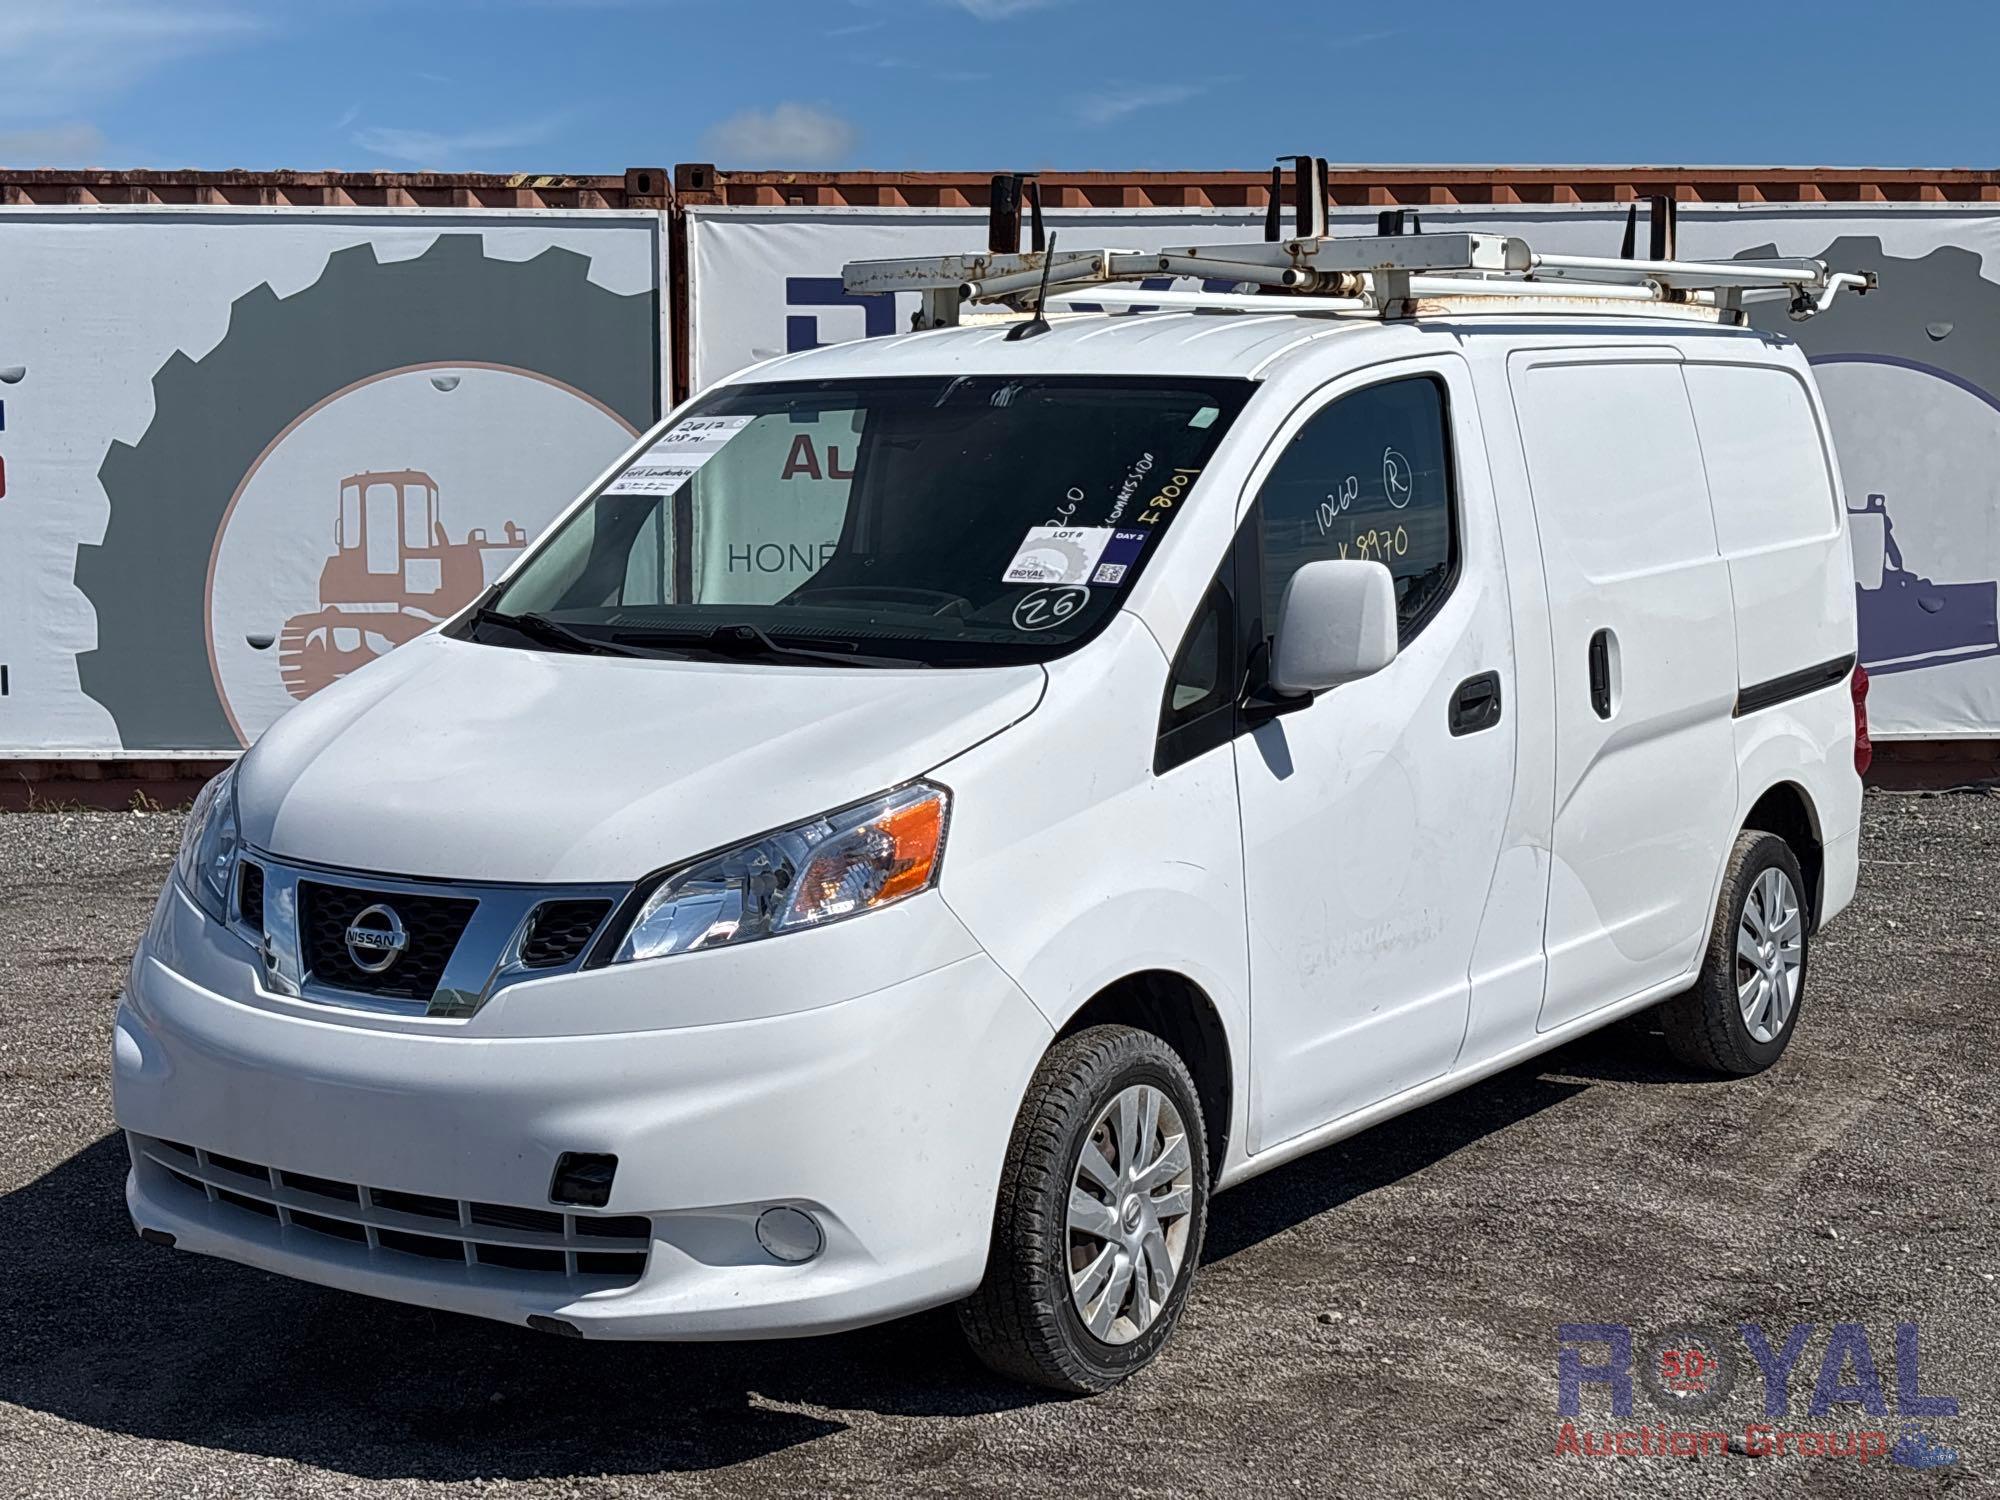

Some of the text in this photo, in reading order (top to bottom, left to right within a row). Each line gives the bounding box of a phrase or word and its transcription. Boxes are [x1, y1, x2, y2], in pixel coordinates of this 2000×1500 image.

[1315, 476, 1359, 536] 10260
[1010, 569, 1045, 577] ROYAL
[346, 929, 396, 947] NISSAN
